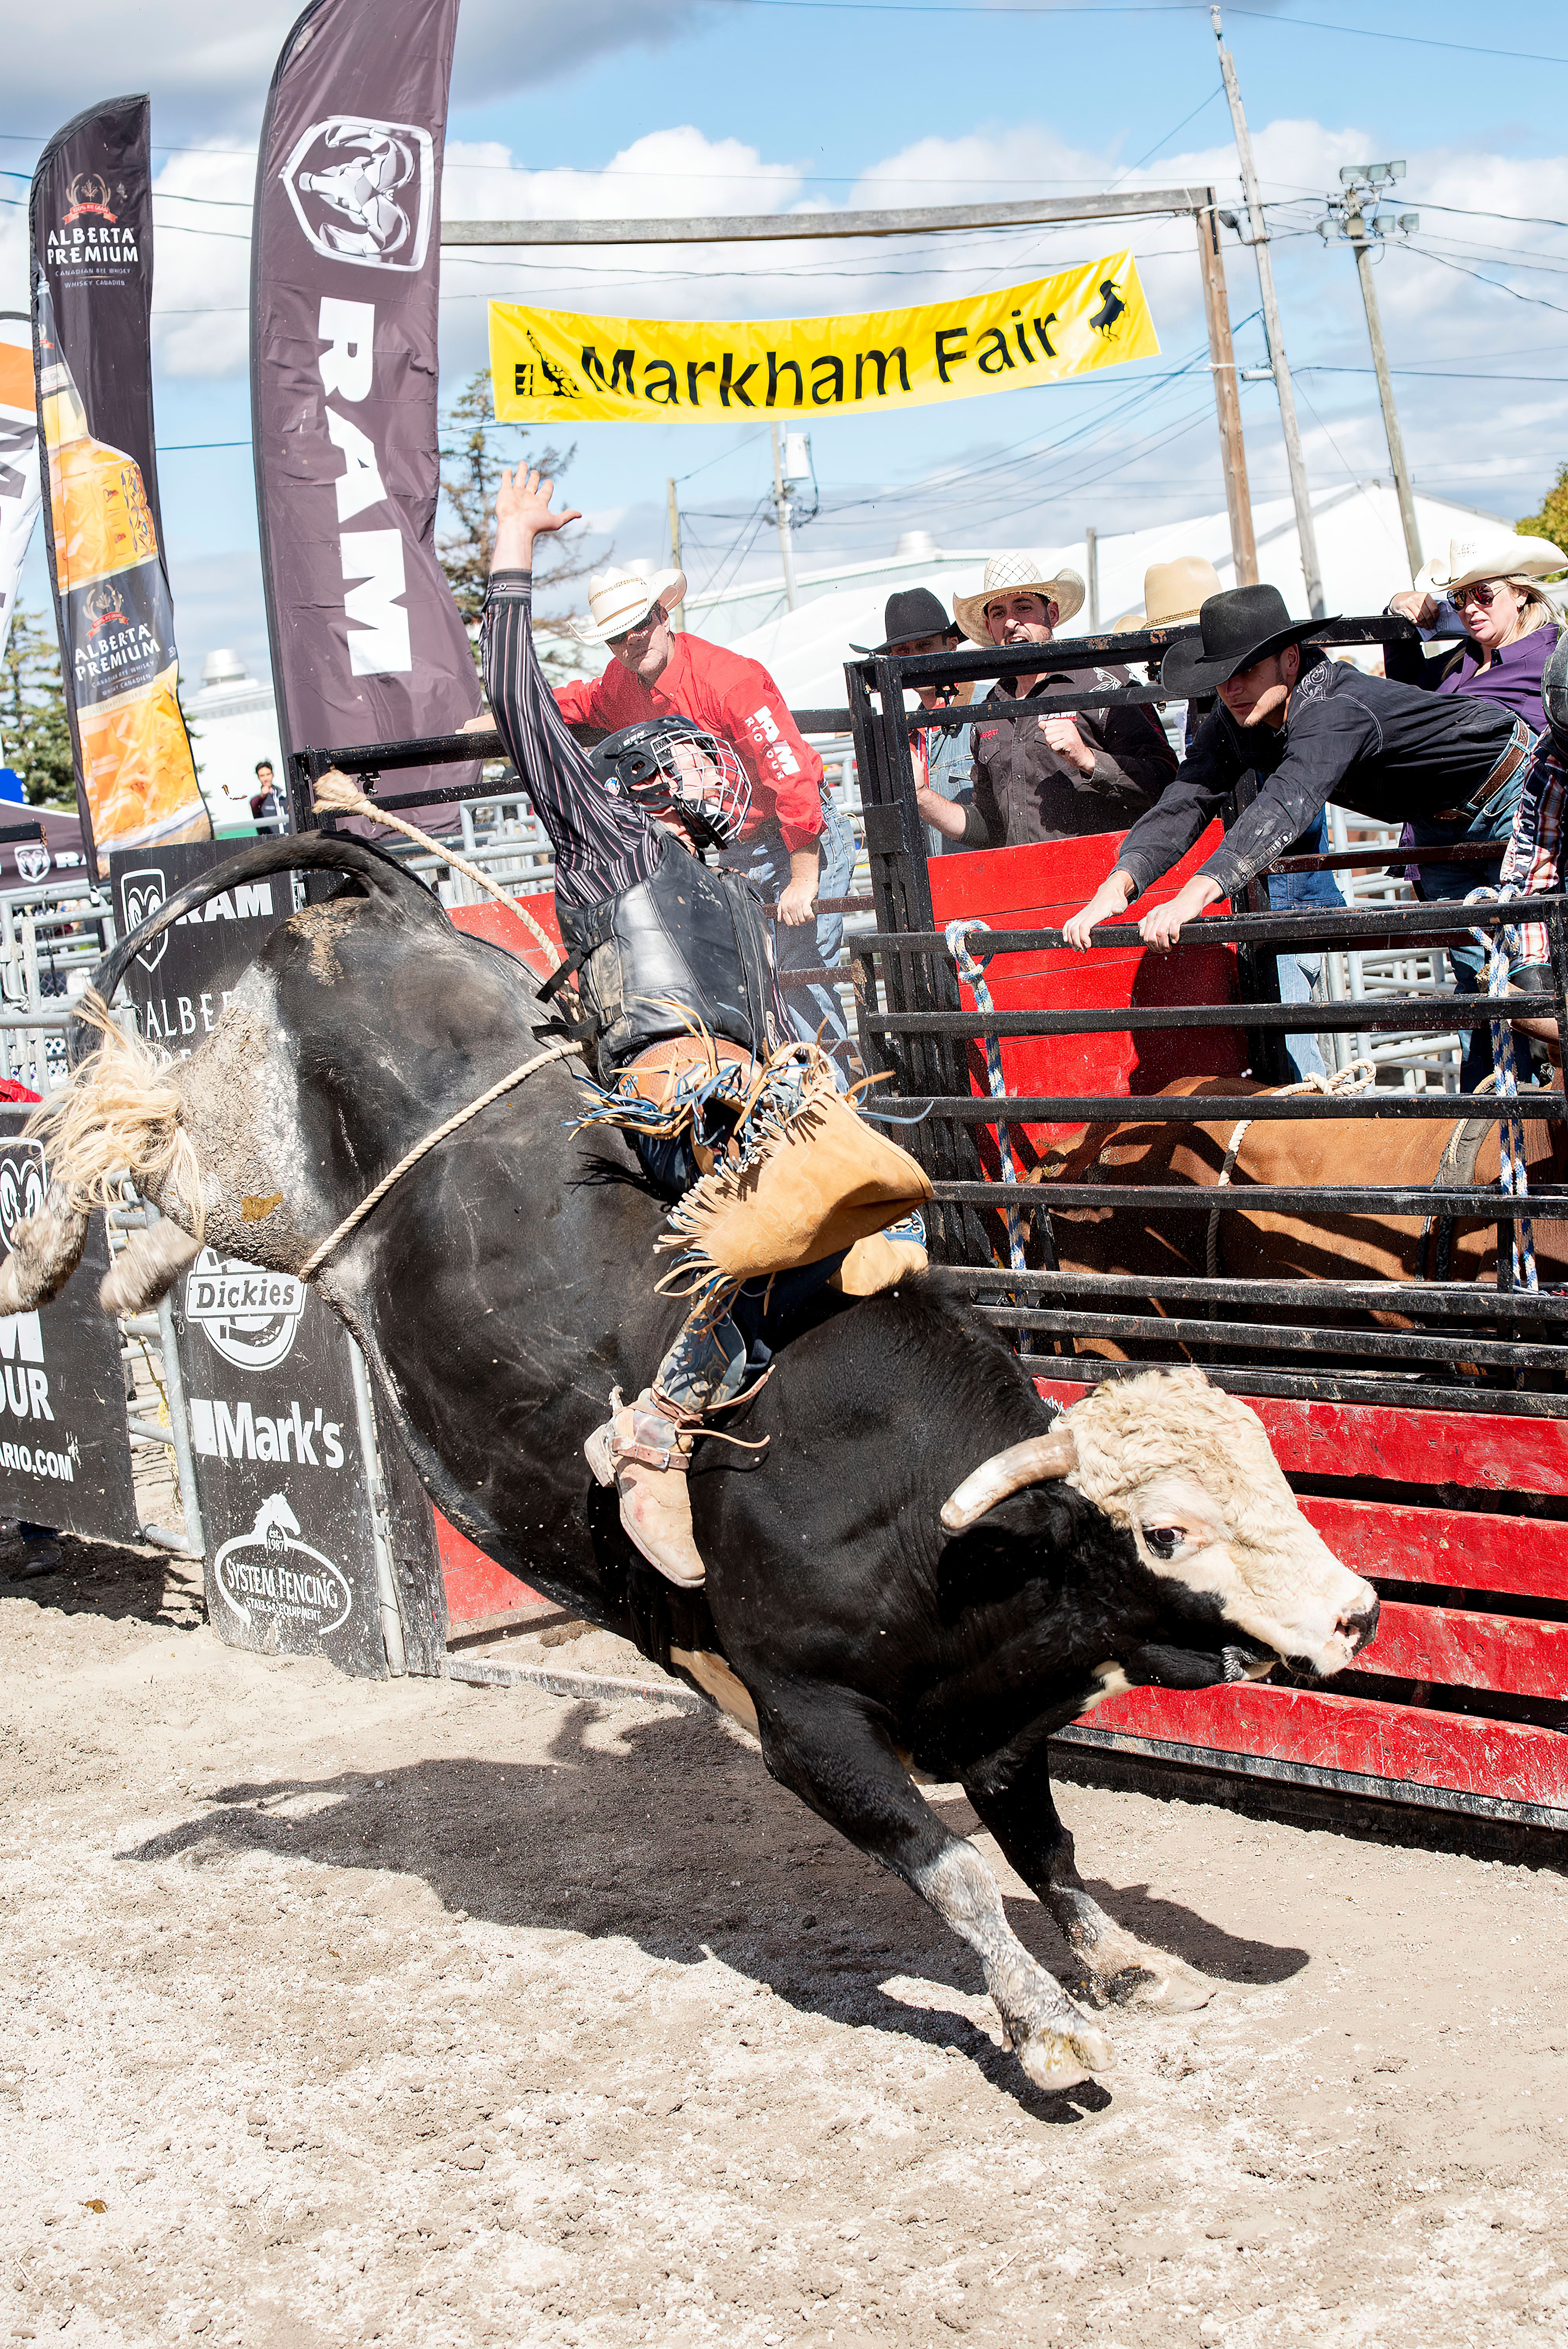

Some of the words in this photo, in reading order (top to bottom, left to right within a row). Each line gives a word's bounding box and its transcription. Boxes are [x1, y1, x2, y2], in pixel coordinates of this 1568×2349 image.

[47, 246, 138, 265] PREMIUM
[48, 227, 135, 245] ALBERTA
[581, 345, 913, 407] Markham
[935, 309, 1059, 384] Fair
[318, 296, 412, 676] RAM
[75, 624, 151, 664] ALBERTA
[75, 639, 161, 681] PREMIUM
[196, 1278, 295, 1308] Dickies
[213, 1401, 344, 1469] Mark's
[268, 1538, 284, 1552] 1987
[226, 1557, 278, 1599] SYSTEM
[278, 1567, 338, 1608] FENCING
